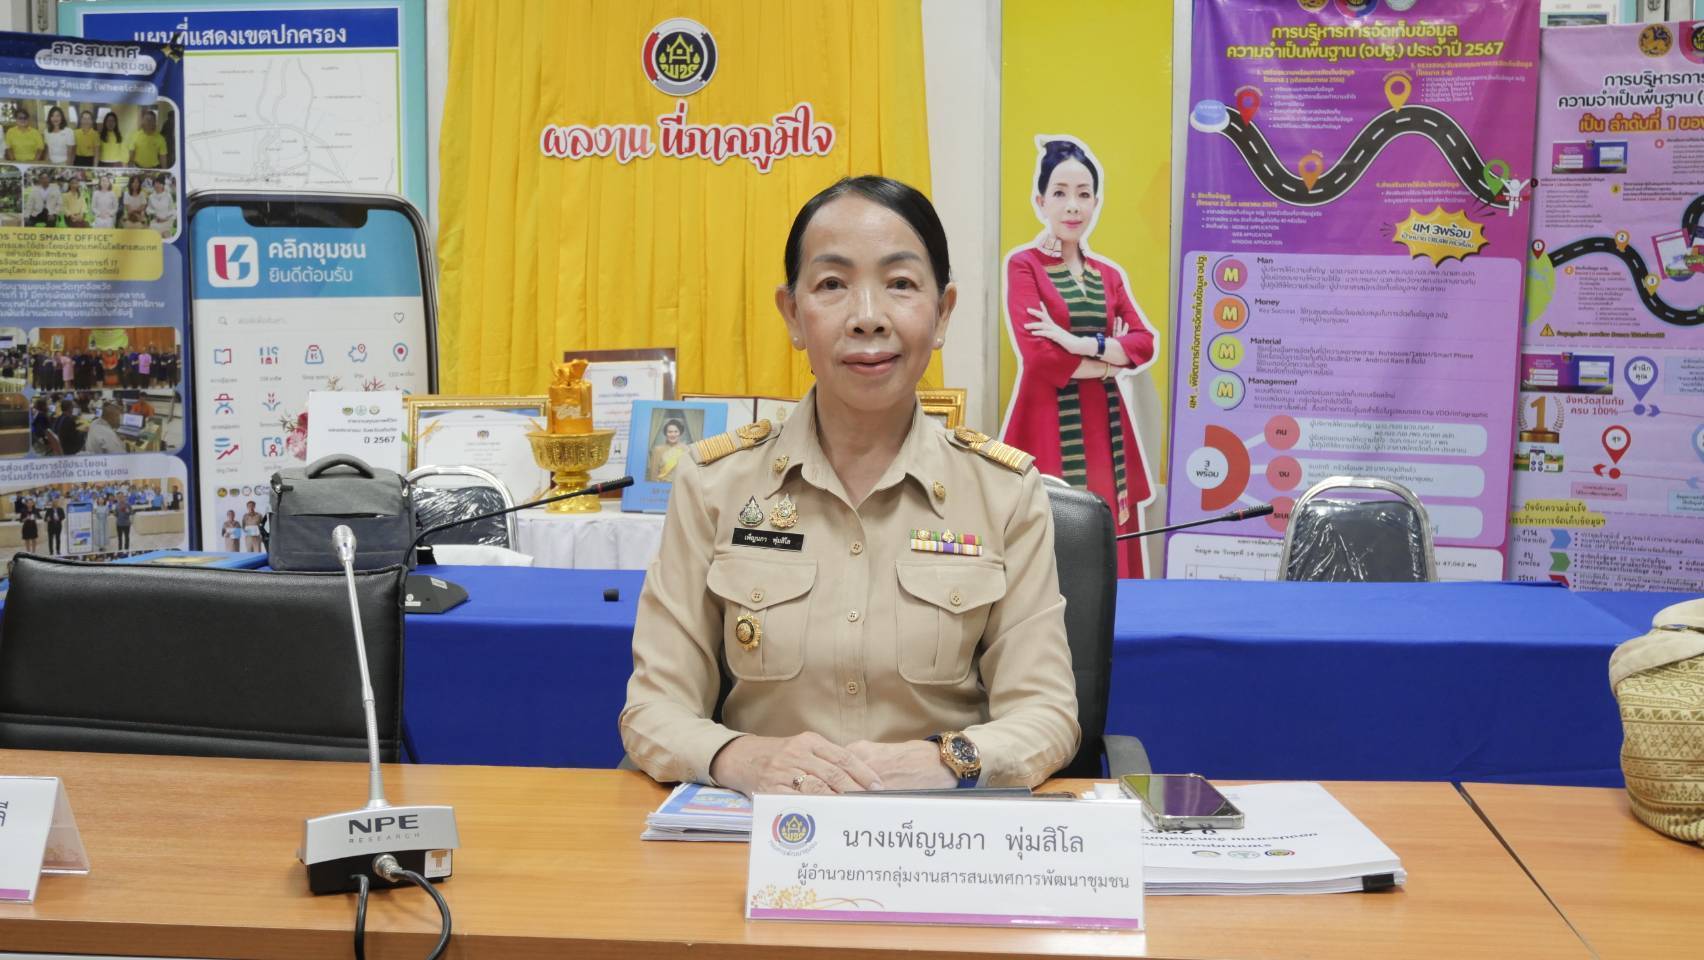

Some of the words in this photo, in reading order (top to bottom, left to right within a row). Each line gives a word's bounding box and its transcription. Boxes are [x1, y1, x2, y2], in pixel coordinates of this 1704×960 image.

[1271, 22, 1458, 44] การบริหารการจัดเก็บข้อมูล
[53, 43, 138, 58] สารสนเทศ
[1226, 42, 1356, 62] ความจำเป็นพื้นฐาน
[1359, 43, 1404, 61] (จปฐ.)
[1407, 41, 1462, 57] ประจำปี
[1465, 42, 1504, 56] 2567
[38, 56, 153, 75] เพื่อการพัฒนาชุมชน
[1558, 88, 1694, 109] ความจำเป็นพื้นฐาน
[1579, 112, 1605, 132] เป็น
[1609, 106, 1662, 132] ลำดับที่
[1667, 115, 1676, 130] 1
[542, 126, 652, 162] ผลงาน
[660, 101, 833, 170] ที่ภาคภูมิใจ
[40, 233, 71, 242] SMART
[1413, 223, 1430, 234] 4M
[1432, 224, 1472, 239] 3พร้อม
[269, 238, 366, 264] คลิกชุมชน
[269, 266, 353, 285] ยินดีต้อนรับ
[1223, 266, 1240, 283] M
[1254, 298, 1280, 307] Money
[1222, 304, 1239, 322] M
[1250, 336, 1282, 345] Material
[1218, 343, 1236, 361] M
[1216, 381, 1234, 399] M
[1248, 377, 1298, 387] Management
[1565, 395, 1625, 407] จังหวัดสุโขทัย
[1570, 407, 1589, 416] ครบ
[1591, 407, 1619, 417] 100%
[374, 435, 396, 444] 2567
[1275, 428, 1287, 436] คน
[1196, 467, 1219, 478] พร้อม
[1203, 460, 1210, 468] 3
[77, 469, 101, 478] Click
[348, 814, 419, 835] NPE
[348, 834, 420, 844] RESEARCH
[842, 820, 985, 857] นางเพ็ญนภา
[1005, 826, 1085, 861] พุ่มสิโล
[797, 863, 1130, 890] ผู้อำนวยการกลุ่มงานสารสนเทศการพัฒนาชุมชน
